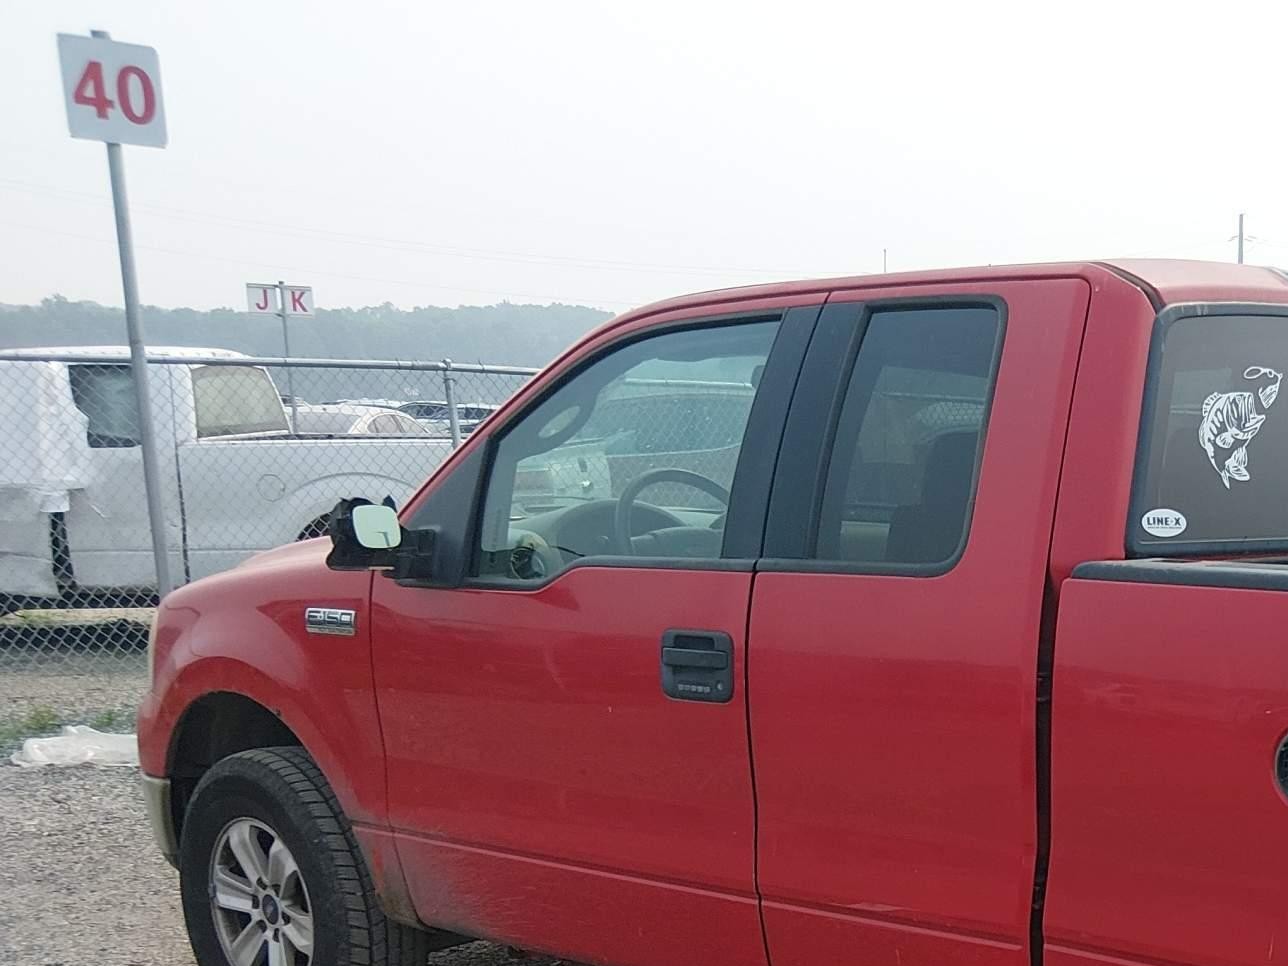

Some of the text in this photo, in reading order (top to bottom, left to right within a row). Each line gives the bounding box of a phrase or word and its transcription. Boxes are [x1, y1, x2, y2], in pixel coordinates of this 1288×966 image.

[73, 60, 156, 125] 40
[256, 288, 269, 311] J
[291, 290, 309, 313] K
